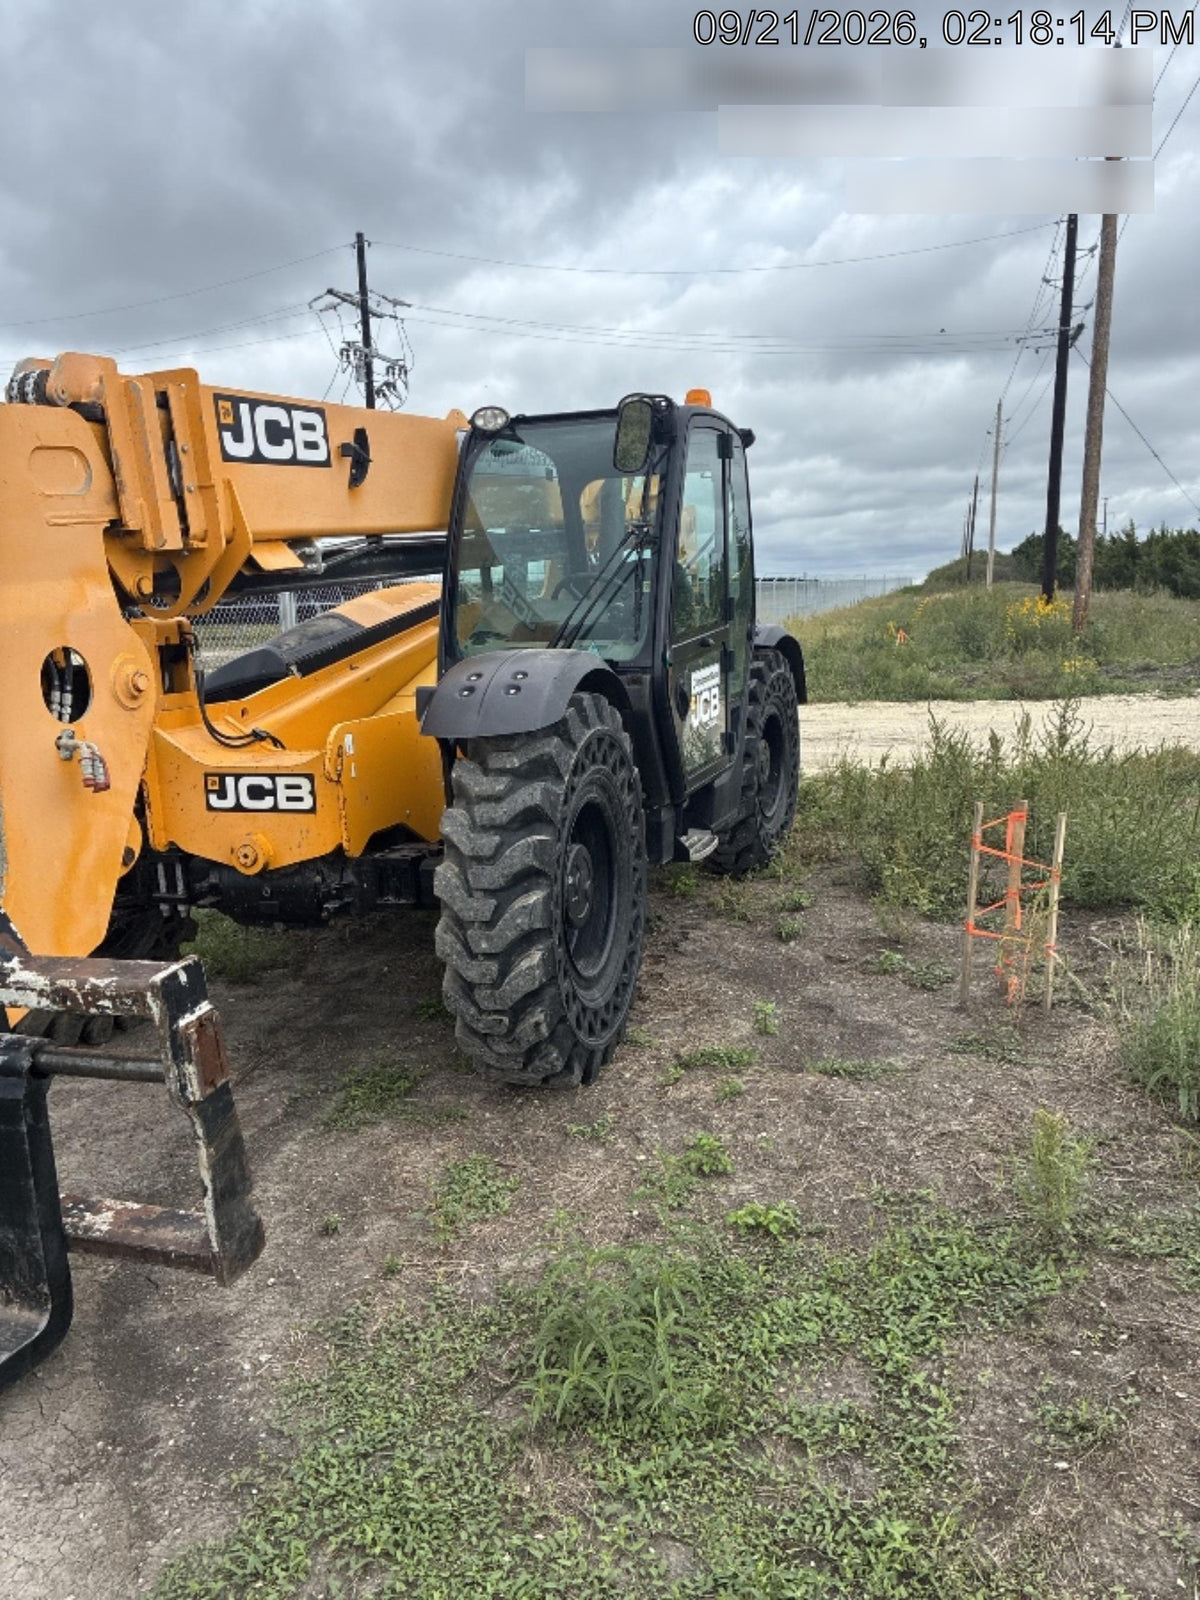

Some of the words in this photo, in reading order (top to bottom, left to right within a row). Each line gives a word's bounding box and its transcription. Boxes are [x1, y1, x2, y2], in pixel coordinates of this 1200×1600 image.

[221, 403, 328, 461] JCB
[690, 686, 719, 728] JCB
[208, 776, 314, 810] JCB
